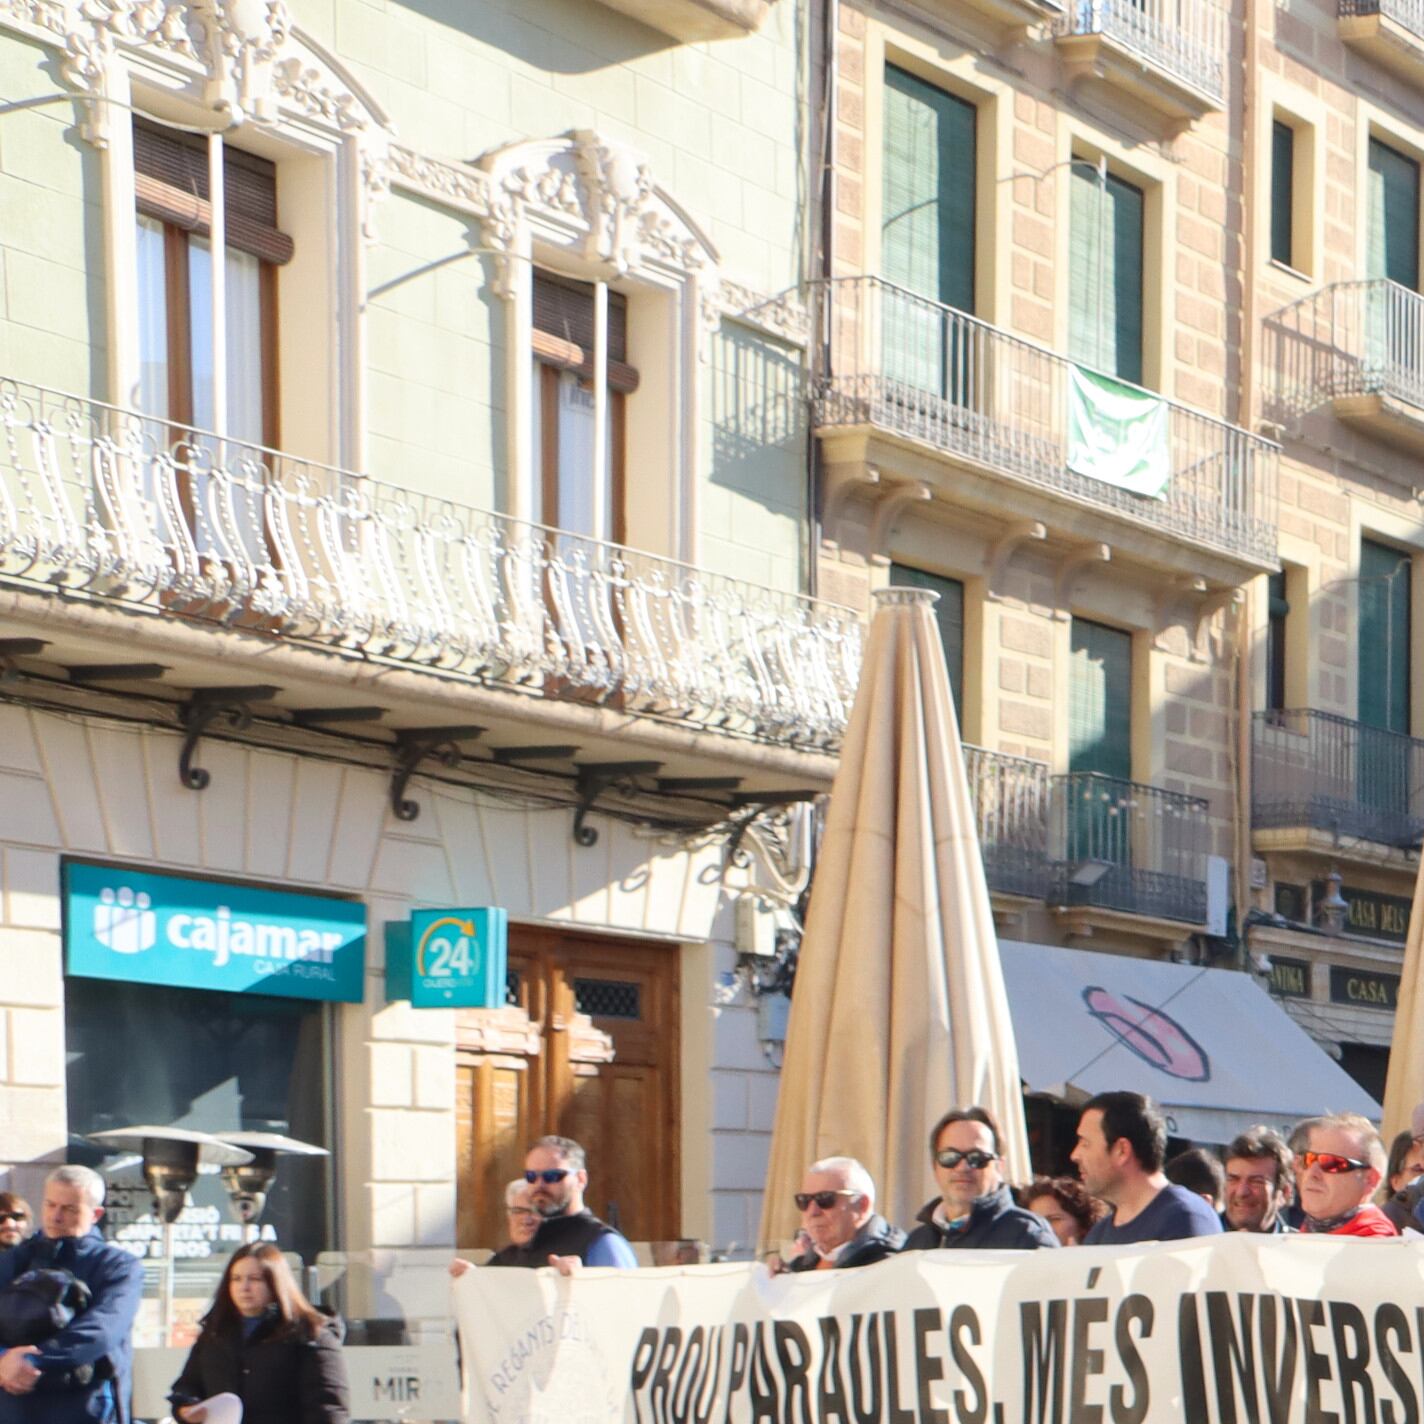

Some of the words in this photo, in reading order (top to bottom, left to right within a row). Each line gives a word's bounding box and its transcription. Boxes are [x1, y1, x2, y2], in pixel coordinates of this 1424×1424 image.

[166, 905, 343, 967] cajamar
[292, 963, 336, 981] RURAL
[1347, 978, 1389, 1004] CASA
[490, 1314, 556, 1395] REGANTS
